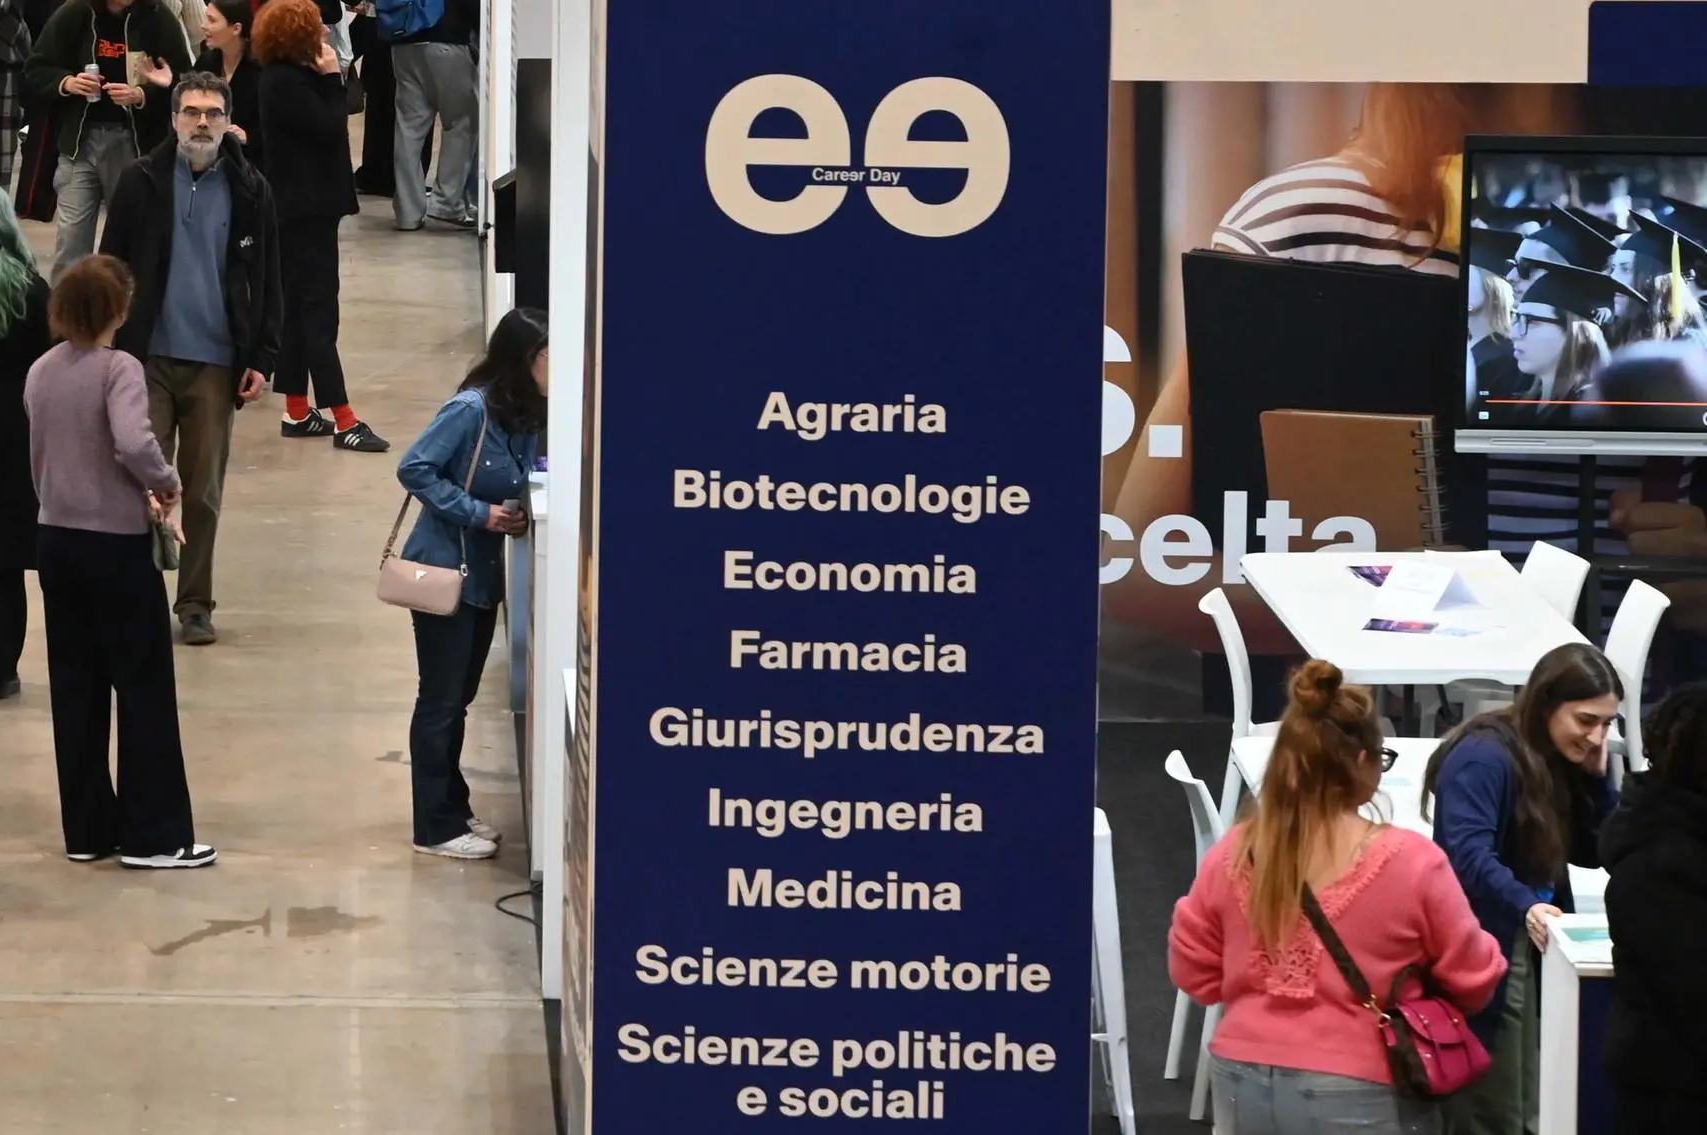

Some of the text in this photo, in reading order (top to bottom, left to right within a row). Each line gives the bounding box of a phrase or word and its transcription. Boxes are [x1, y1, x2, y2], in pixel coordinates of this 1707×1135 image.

[812, 167, 901, 185] Career Day
[757, 392, 946, 441] Agraria
[674, 470, 1031, 524] Biotecnologie
[724, 551, 976, 594] Economia
[731, 630, 967, 673] Farmacia
[650, 707, 1044, 758] Giurisprudenza
[709, 788, 983, 839] Ingegneria
[728, 868, 961, 911] Medicina
[636, 945, 1051, 993] Scienze motorie
[618, 1024, 1056, 1077] Scienze politiche
[737, 1080, 944, 1119] e sociali
